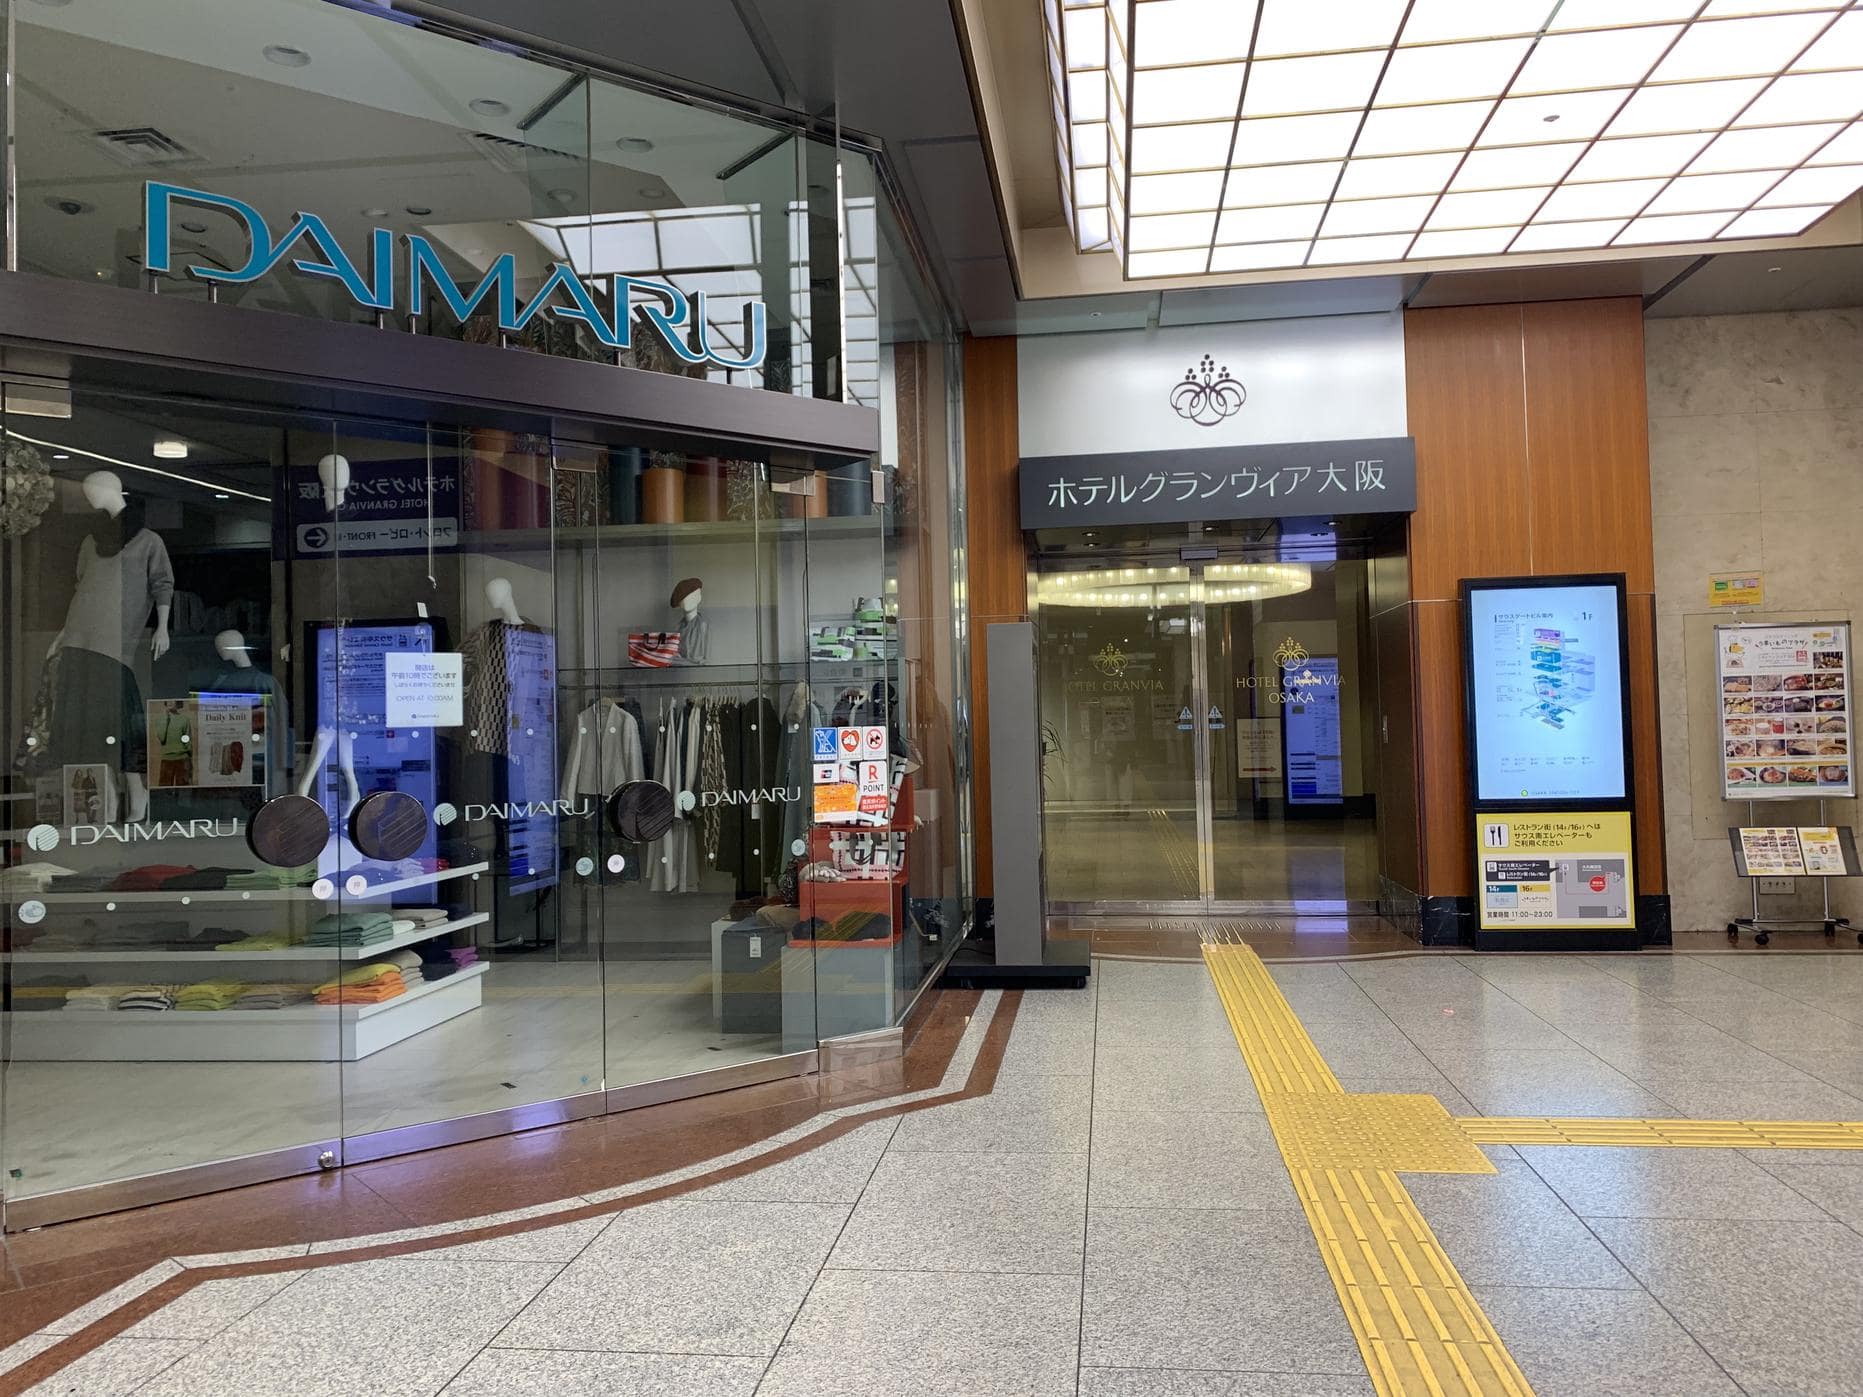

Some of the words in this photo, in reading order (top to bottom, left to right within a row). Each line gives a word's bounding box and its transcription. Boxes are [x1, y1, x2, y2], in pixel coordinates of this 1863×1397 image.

[145, 180, 767, 369] DAIMARU
[1048, 459, 1386, 508] ホテルグランヴィア大阪
[1065, 681, 1096, 692] OTEL
[1236, 676, 1277, 689] HOTEL
[1283, 674, 1346, 689] GRANVIA
[1268, 692, 1315, 704] OSAKA
[205, 713, 226, 723] Daily
[228, 712, 247, 721] Knit
[868, 765, 878, 780] R
[863, 784, 884, 793] POINT
[701, 786, 801, 807] DAIMARU
[464, 798, 589, 821] DAIMARU
[71, 817, 238, 846] DAIMARU
